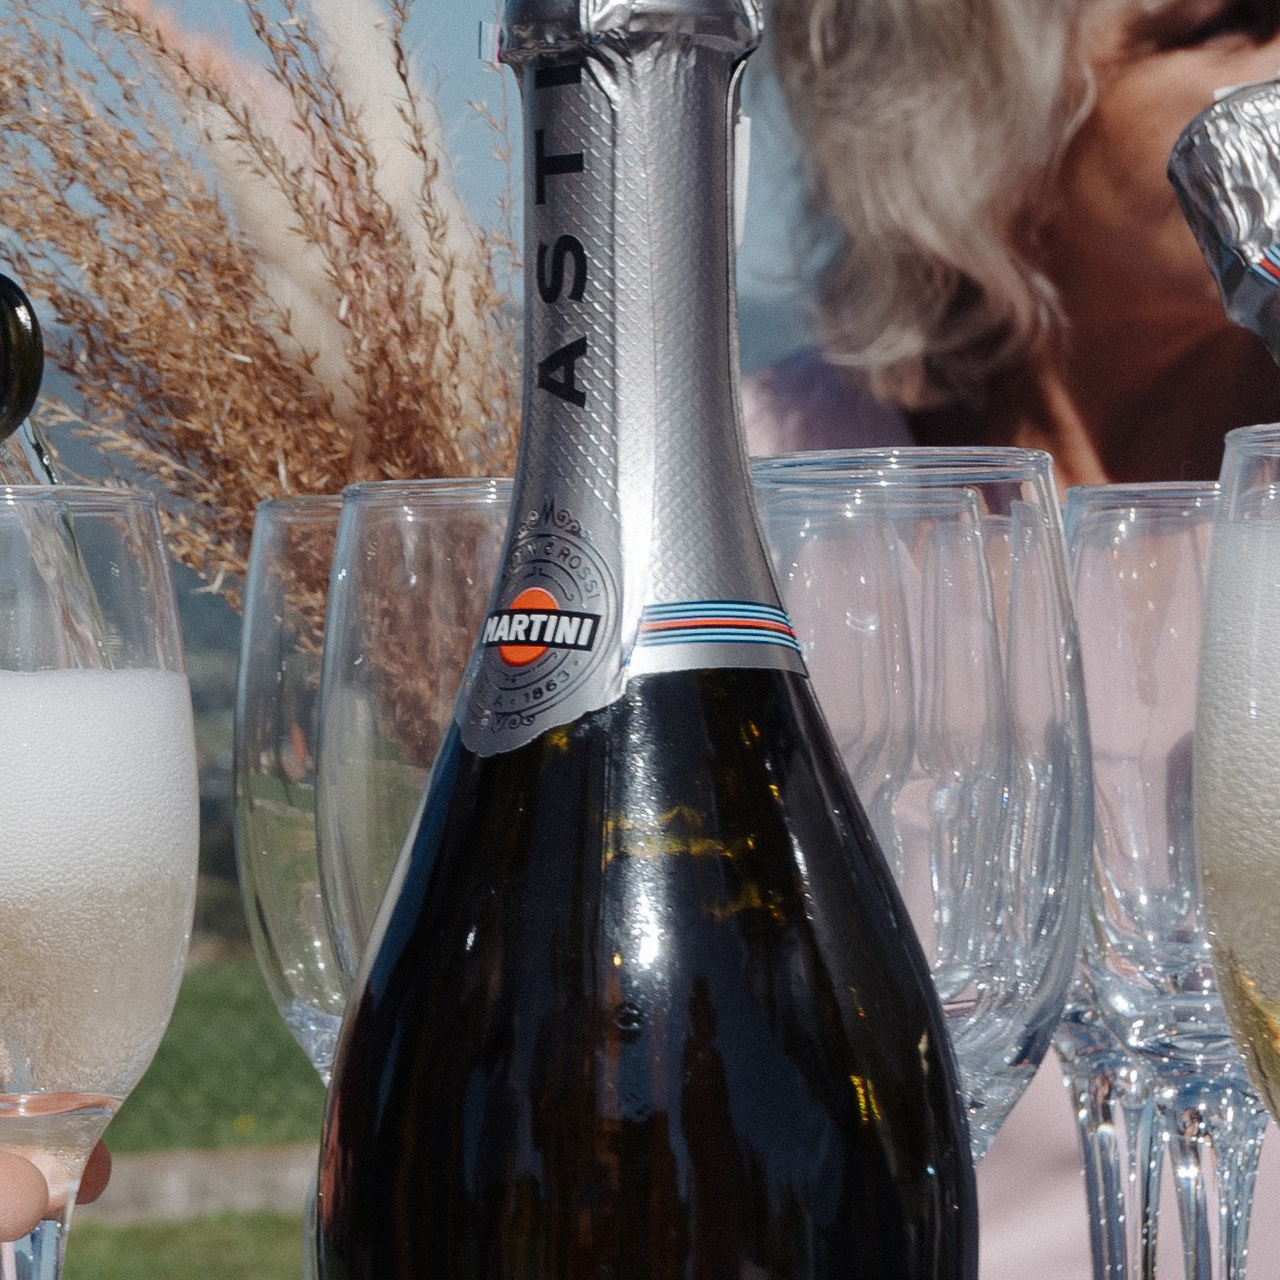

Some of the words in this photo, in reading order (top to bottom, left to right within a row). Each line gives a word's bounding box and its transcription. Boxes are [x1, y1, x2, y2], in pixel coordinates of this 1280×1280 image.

[535, 64, 588, 410] ASTI
[557, 545, 601, 600] ROSSI
[482, 613, 595, 647] MARTINI
[523, 671, 571, 704] 1863
